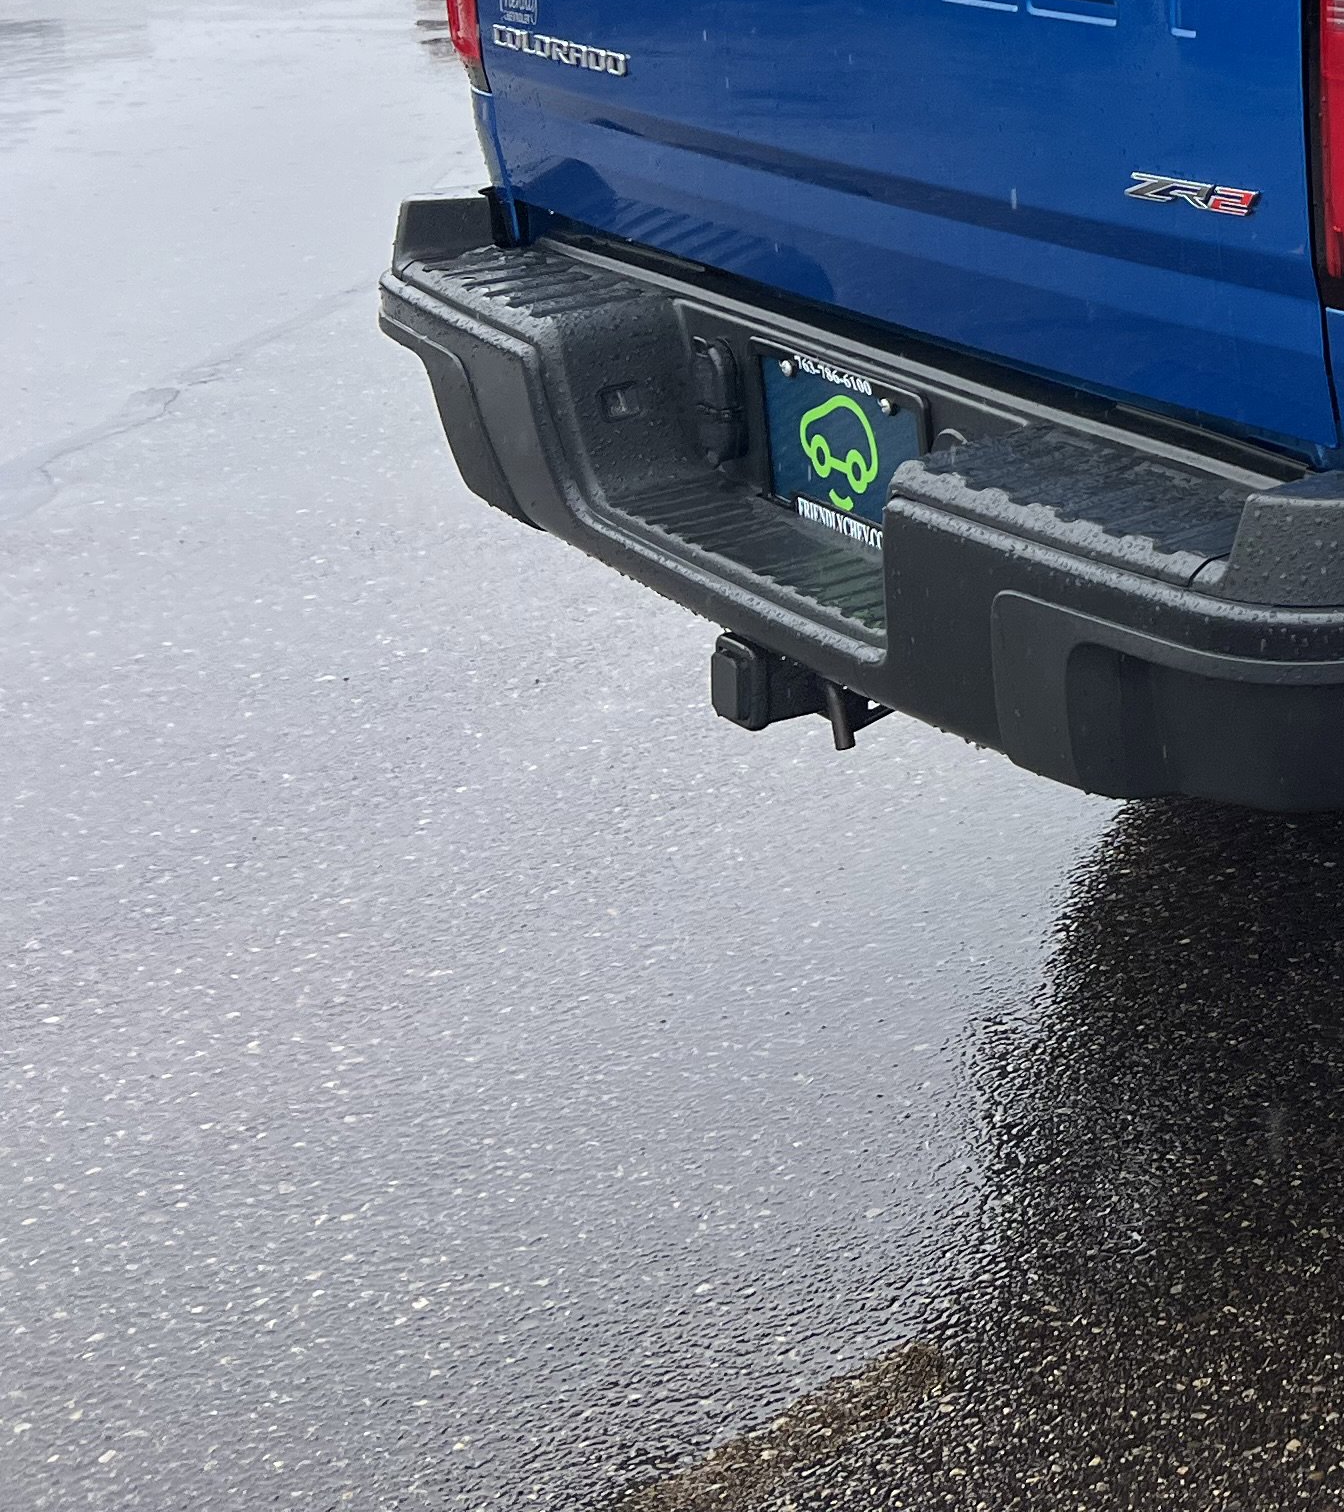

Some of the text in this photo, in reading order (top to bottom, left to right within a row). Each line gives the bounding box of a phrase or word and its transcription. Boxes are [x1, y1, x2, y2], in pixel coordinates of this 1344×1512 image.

[492, 23, 628, 76] COLORADO
[1124, 171, 1259, 217] ZR2
[794, 355, 872, 395] 763-786-6100
